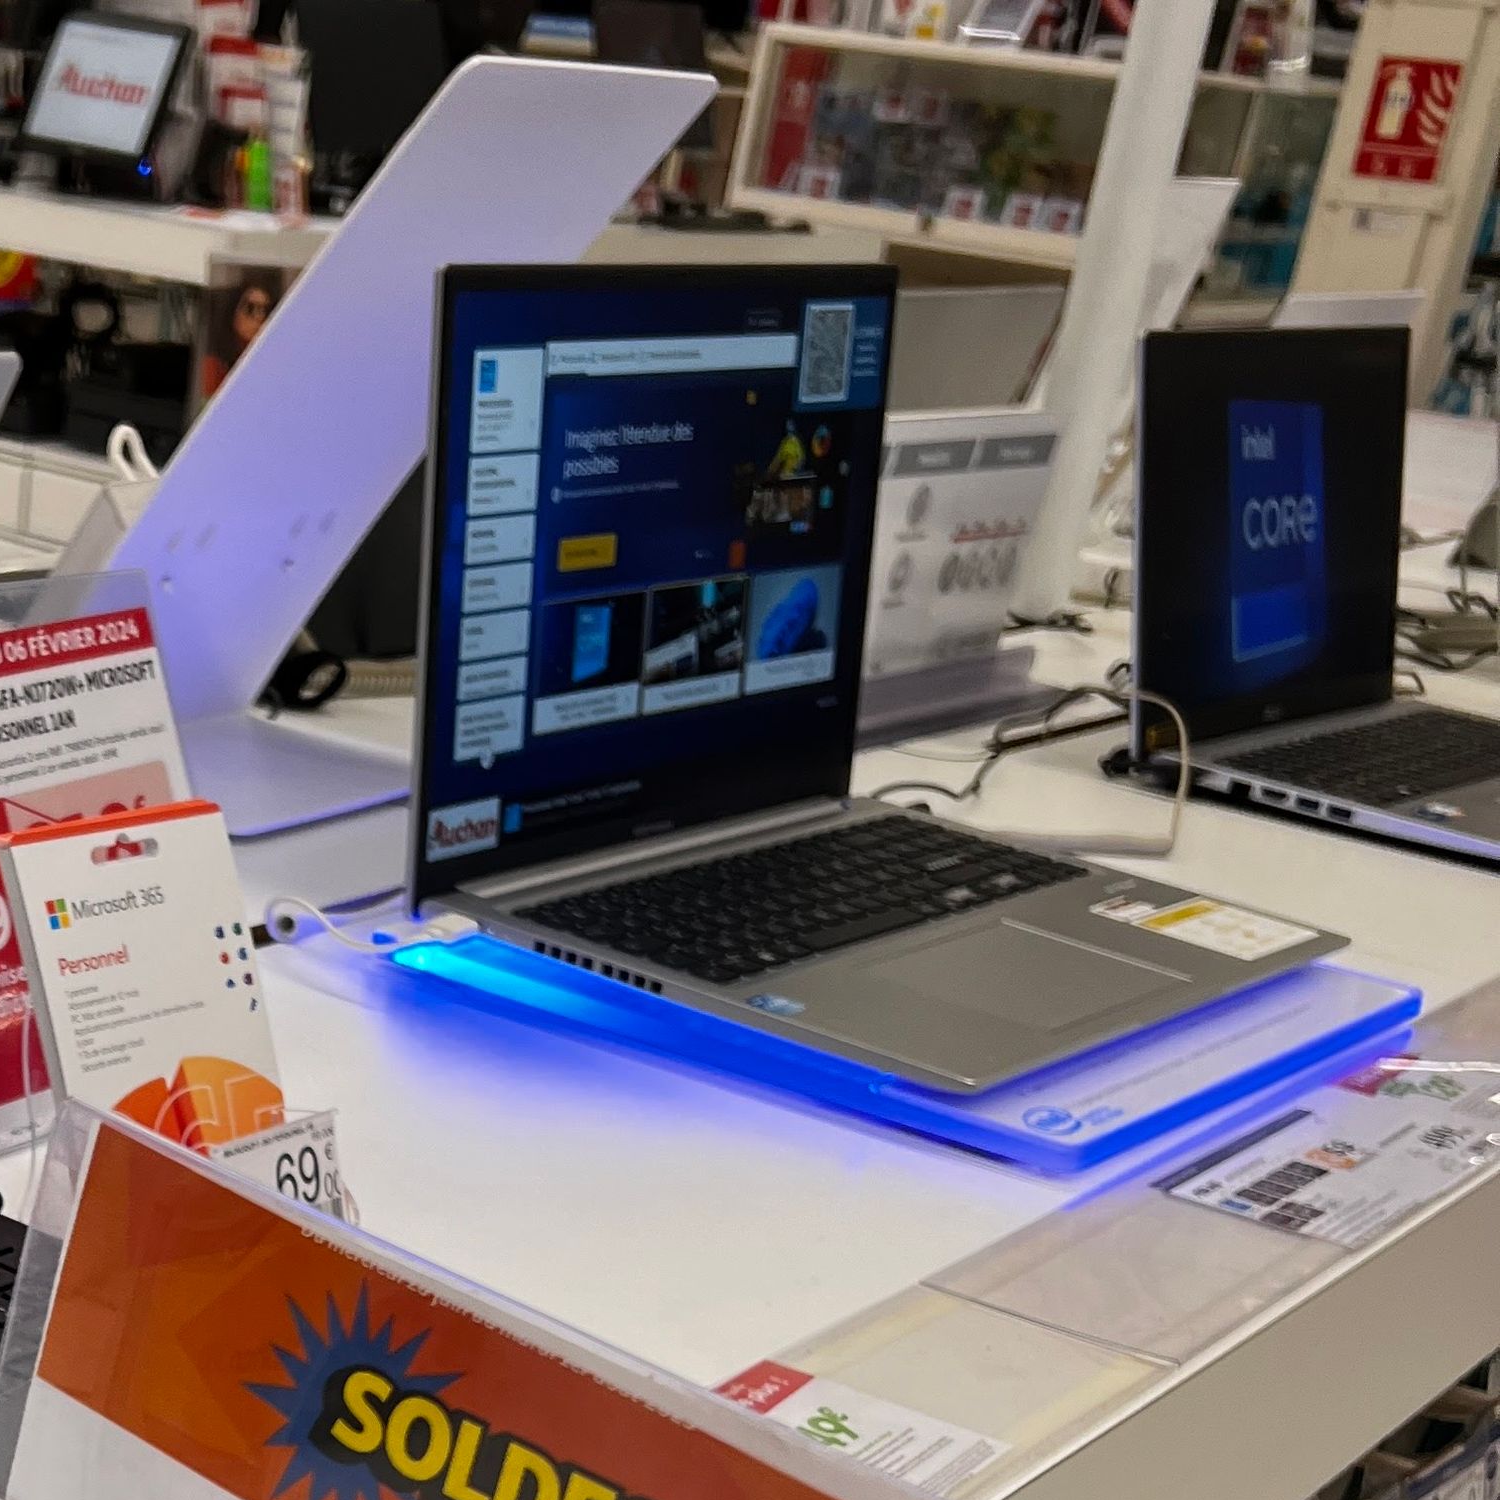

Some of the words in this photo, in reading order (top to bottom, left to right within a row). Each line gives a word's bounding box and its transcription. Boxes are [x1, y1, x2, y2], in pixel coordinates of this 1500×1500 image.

[26, 628, 98, 659] FÉVRIER
[84, 660, 156, 692] MICROSOFT
[429, 814, 498, 850] Auchan
[70, 887, 140, 921] Microsoft
[139, 885, 166, 908] 365
[57, 943, 131, 977] Personnel
[275, 1146, 321, 1204] 69
